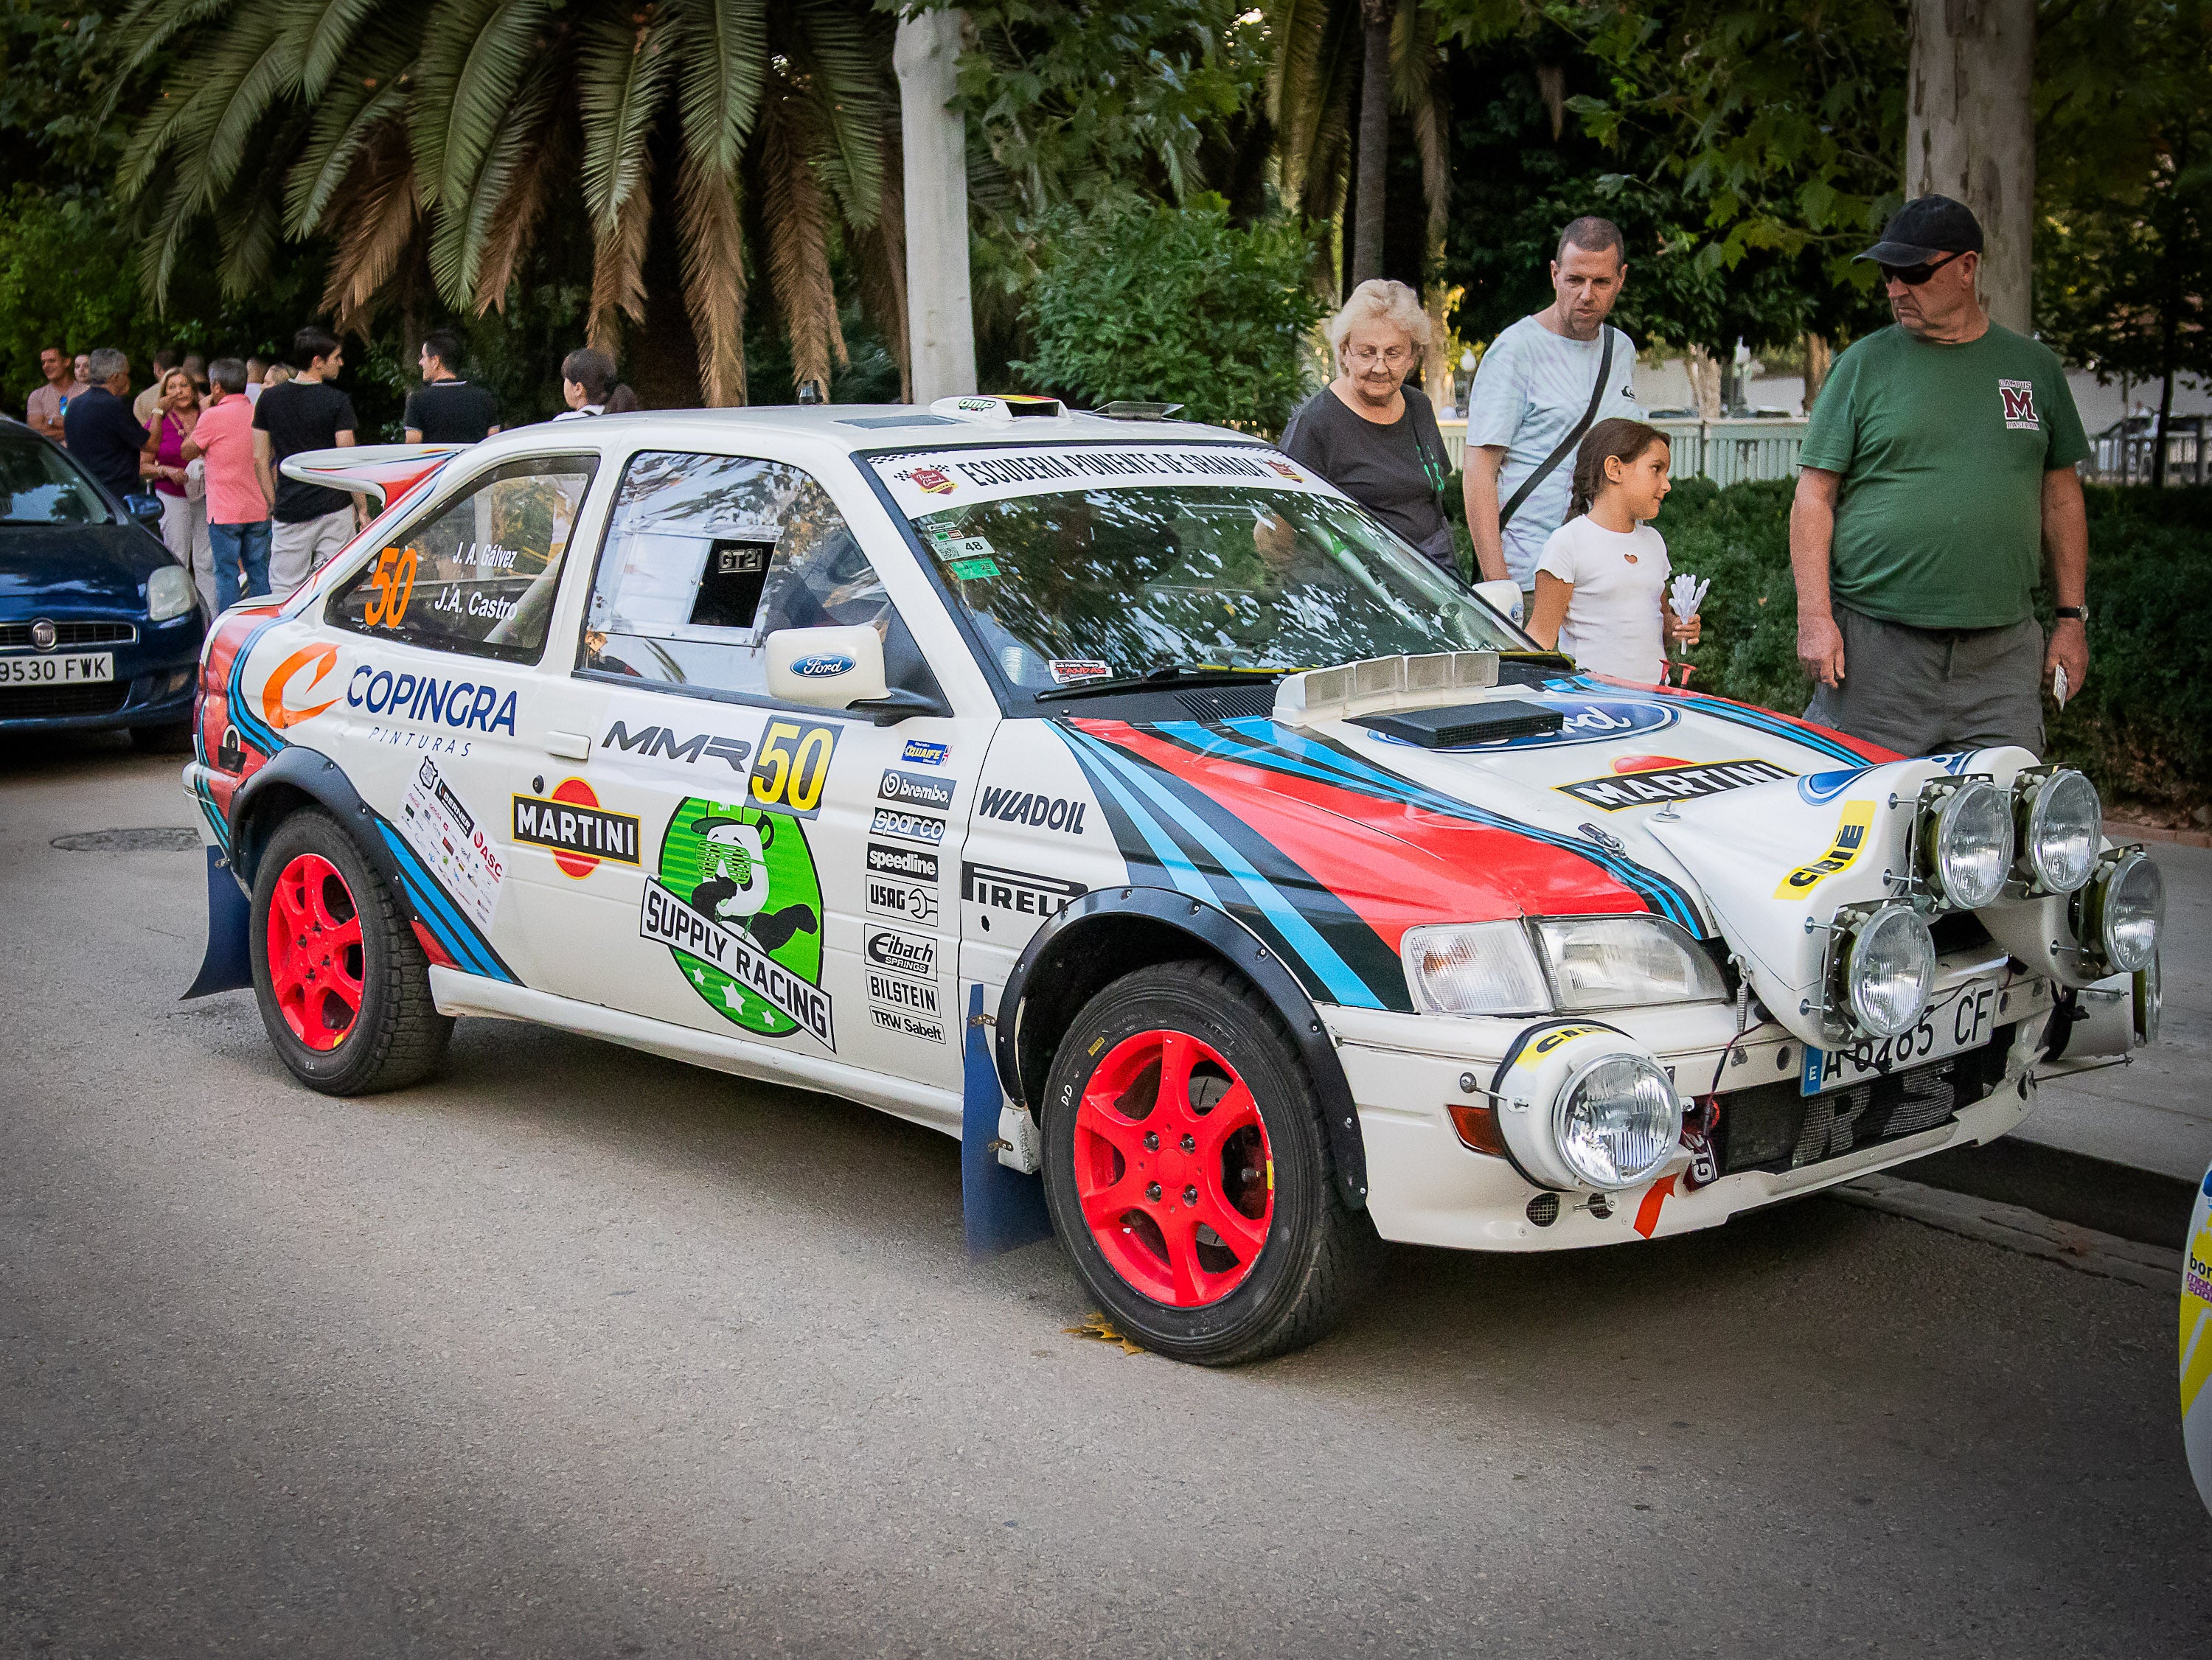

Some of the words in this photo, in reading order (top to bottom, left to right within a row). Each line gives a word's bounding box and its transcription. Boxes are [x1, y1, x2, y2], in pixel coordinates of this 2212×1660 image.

[1999, 379, 2032, 390] CAMPUS
[1999, 387, 2039, 422] M
[956, 454, 1079, 487] ESCUDERIA
[1062, 453, 1169, 476] PONIENTE
[1152, 453, 1195, 474] DE
[1180, 454, 1272, 478] GRANADA
[480, 543, 518, 569] Gálvez
[965, 541, 984, 551] 48
[364, 547, 417, 629] 50
[468, 591, 518, 621] Castro
[0, 660, 55, 683] 9530
[65, 657, 107, 680] FWK
[803, 655, 843, 674] Ford
[347, 665, 518, 737] COPINGRA
[368, 727, 472, 757] PINTURAS
[601, 720, 752, 773] MMR
[908, 747, 943, 760] QUAIFE
[751, 722, 835, 812] 50
[1573, 762, 1792, 806] MARTINI
[444, 791, 471, 831] BERNER
[874, 810, 945, 839] sparco
[518, 803, 634, 856] MARTINI
[480, 845, 503, 877] ASC
[869, 850, 936, 876] speedline
[870, 883, 905, 910] USAG
[868, 932, 933, 964] Eibach
[645, 890, 728, 963] SUPPLY
[736, 946, 827, 1039] RACING
[884, 956, 927, 973] SPRINGS
[870, 975, 936, 1012] BILSTEIN
[872, 1009, 902, 1030] TRW
[903, 1018, 942, 1041] Sabelt
[1954, 988, 1994, 1046] CF
[1809, 1065, 1817, 1081] E
